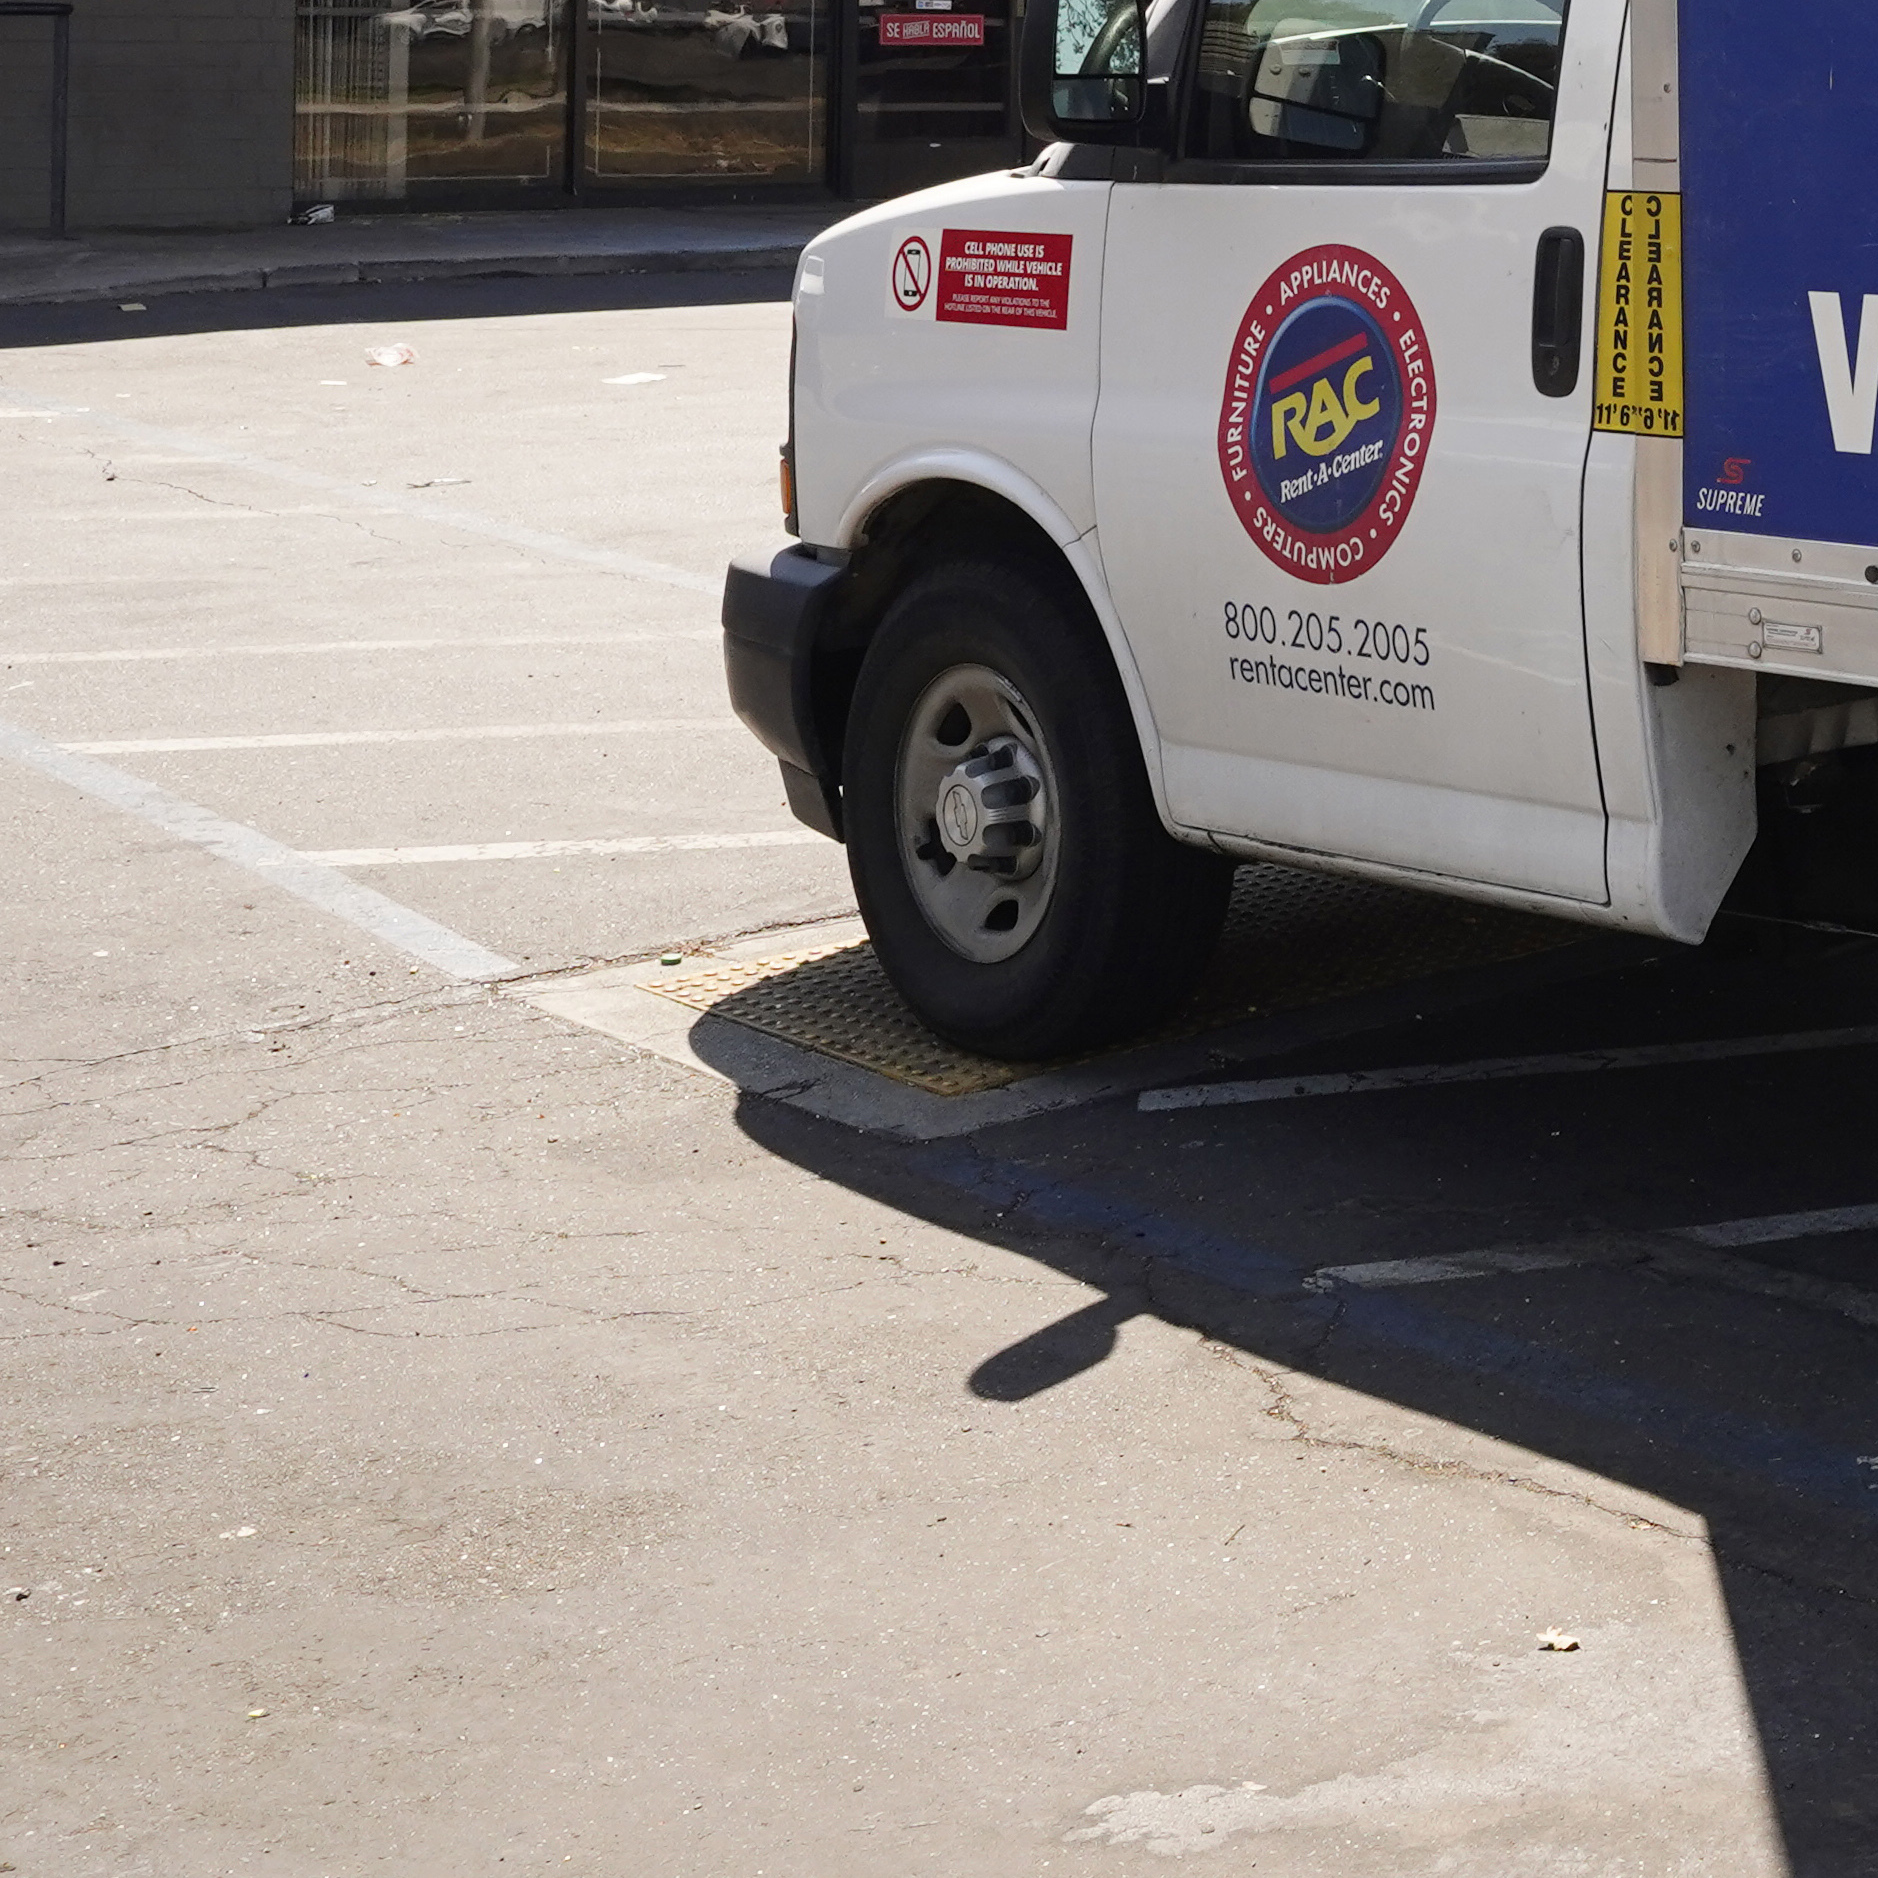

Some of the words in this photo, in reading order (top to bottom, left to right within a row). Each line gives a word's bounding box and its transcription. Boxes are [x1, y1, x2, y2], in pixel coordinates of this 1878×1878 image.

[886, 23, 900, 38] SE
[903, 21, 930, 39] HABLA
[932, 20, 981, 39] ESPAÑOL
[945, 257, 995, 272] PROHIBITED
[996, 260, 1025, 274] WHILE
[1026, 262, 1063, 276] VEHICLE
[964, 241, 984, 255] CELL
[985, 242, 1016, 257] PHONE
[1017, 244, 1034, 258] USE
[1035, 245, 1044, 258] IS
[964, 274, 973, 287] IS
[974, 275, 984, 288] IN
[985, 276, 1039, 291] OPERATION.
[1279, 259, 1392, 309] APPLIANCES
[1611, 195, 1633, 399] CLEARANCE
[1226, 320, 1266, 482] FURNITURE
[1271, 356, 1380, 460] RAC
[1379, 328, 1428, 526] ELECTRONICS
[1696, 487, 1765, 517] SUPREME
[1252, 506, 1365, 570] COMPUTERS
[1224, 601, 1430, 666] 800.205.2005
[1229, 654, 1435, 711] rentacenter.com
